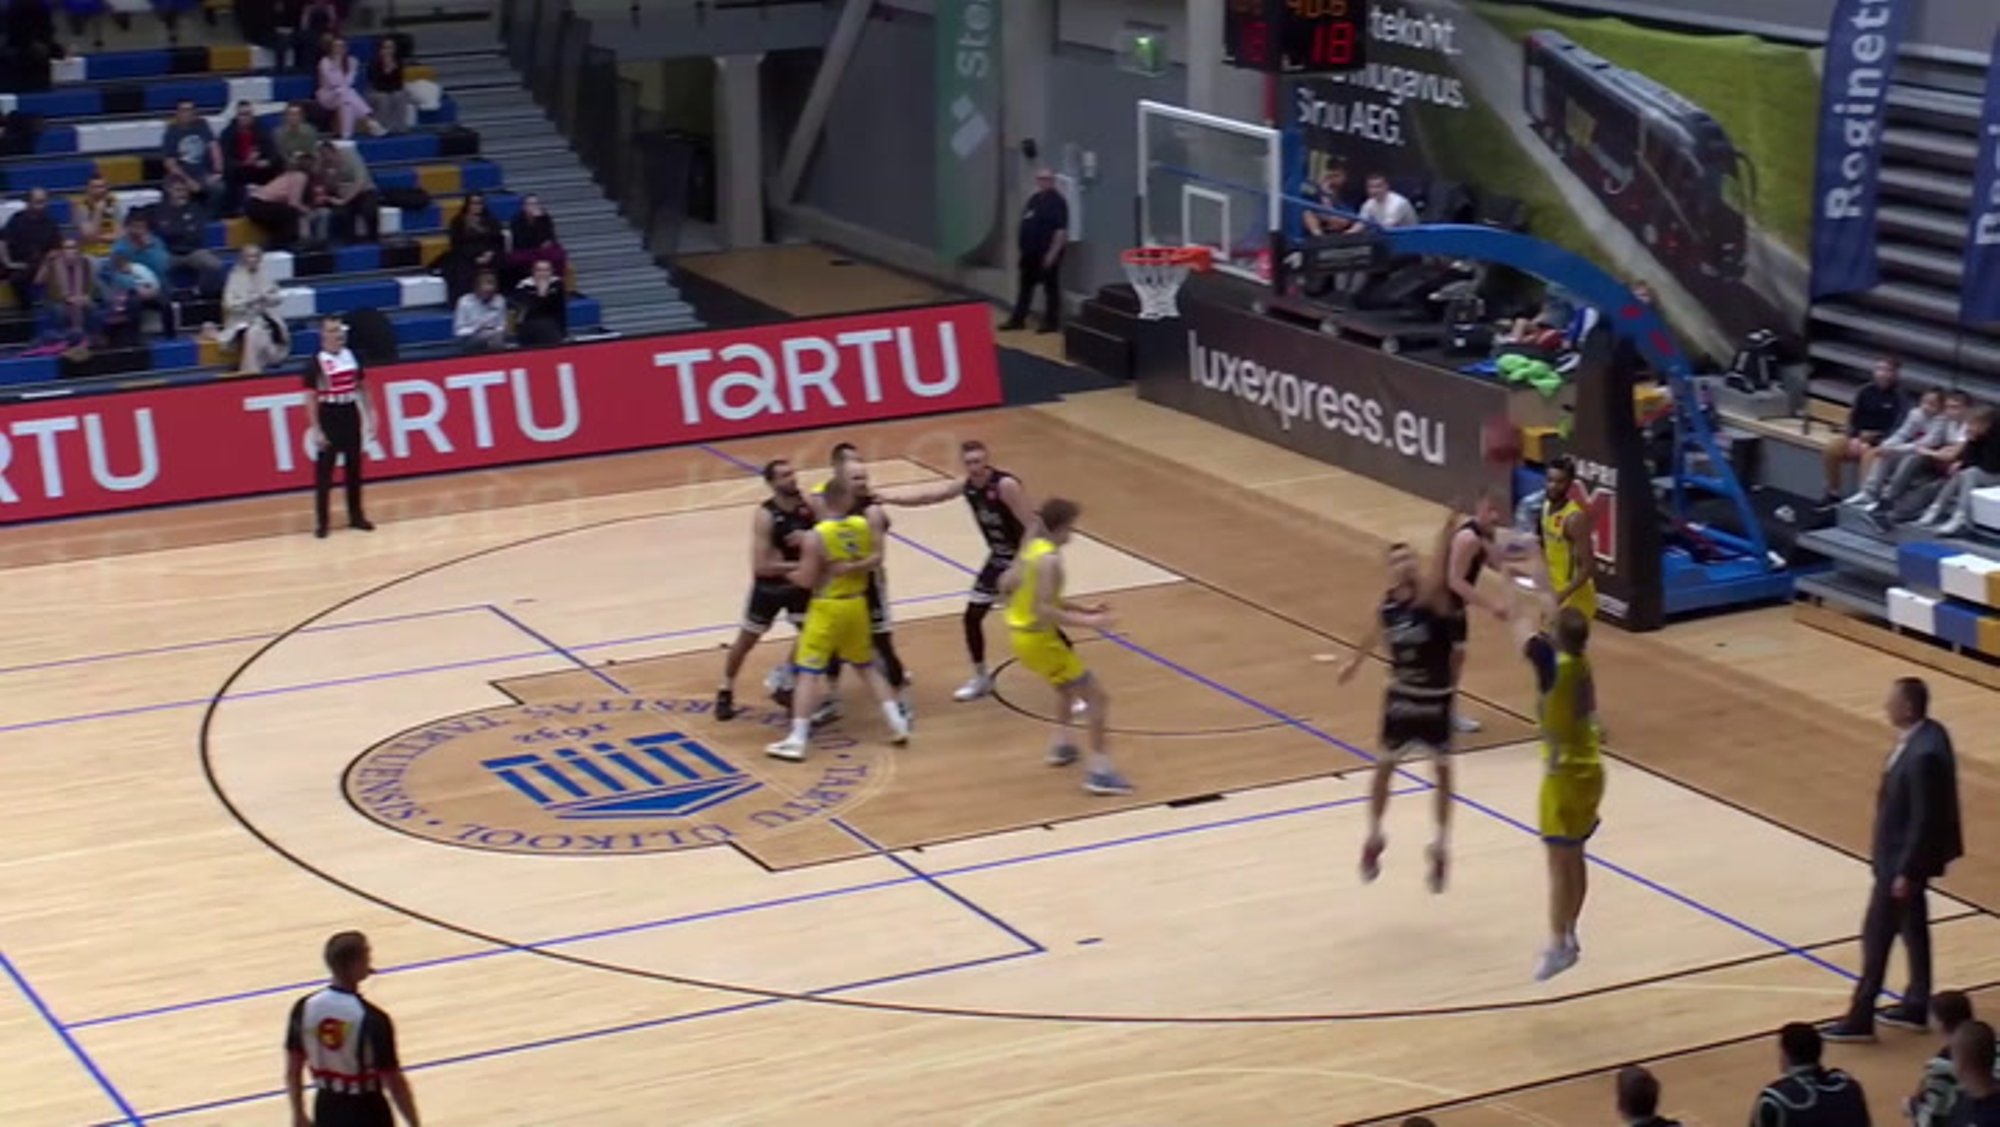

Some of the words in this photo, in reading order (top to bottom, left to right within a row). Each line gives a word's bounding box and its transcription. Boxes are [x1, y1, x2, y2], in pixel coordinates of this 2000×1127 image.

[1311, 21, 1355, 63] 18
[1825, 0, 1891, 219] Roginet
[1188, 329, 1446, 464] luxexpress.eu
